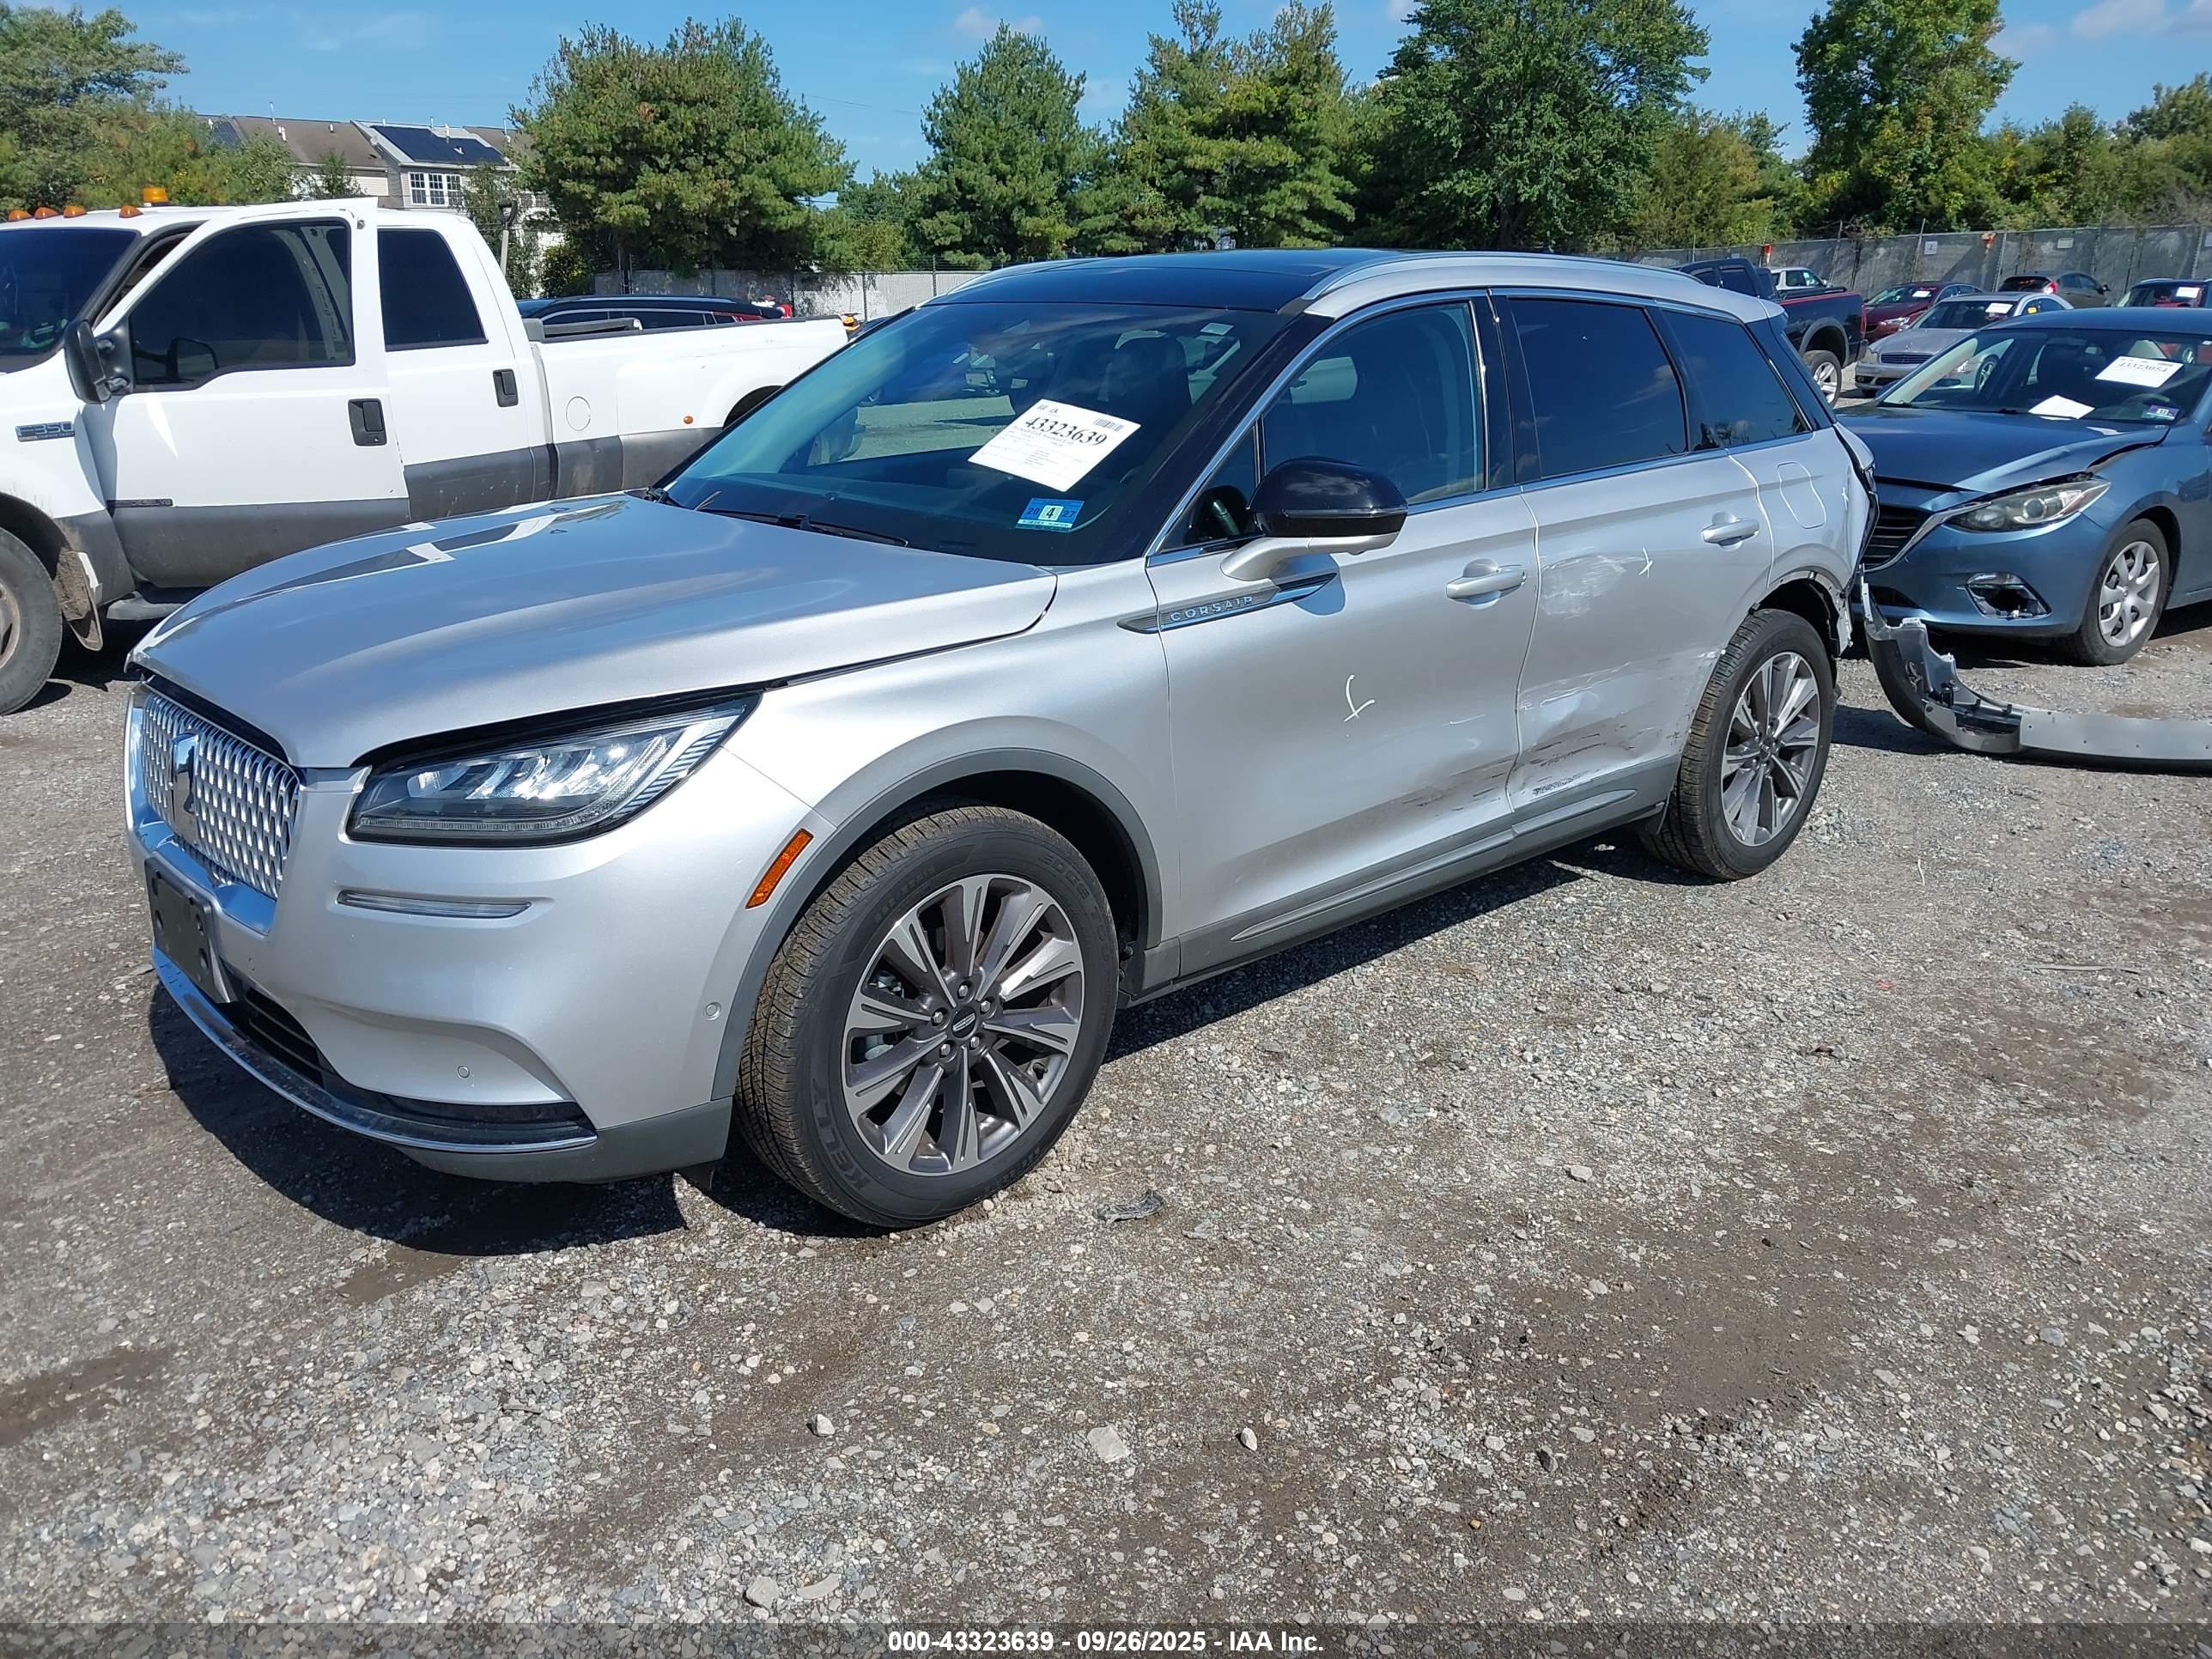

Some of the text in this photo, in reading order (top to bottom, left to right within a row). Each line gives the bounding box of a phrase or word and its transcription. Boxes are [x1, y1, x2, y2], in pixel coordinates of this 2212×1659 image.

[1025, 416, 1108, 446] 43323639
[1046, 507, 1056, 519] 4
[1170, 596, 1254, 622] CORSAIR
[812, 1078, 871, 1191] KELLY
